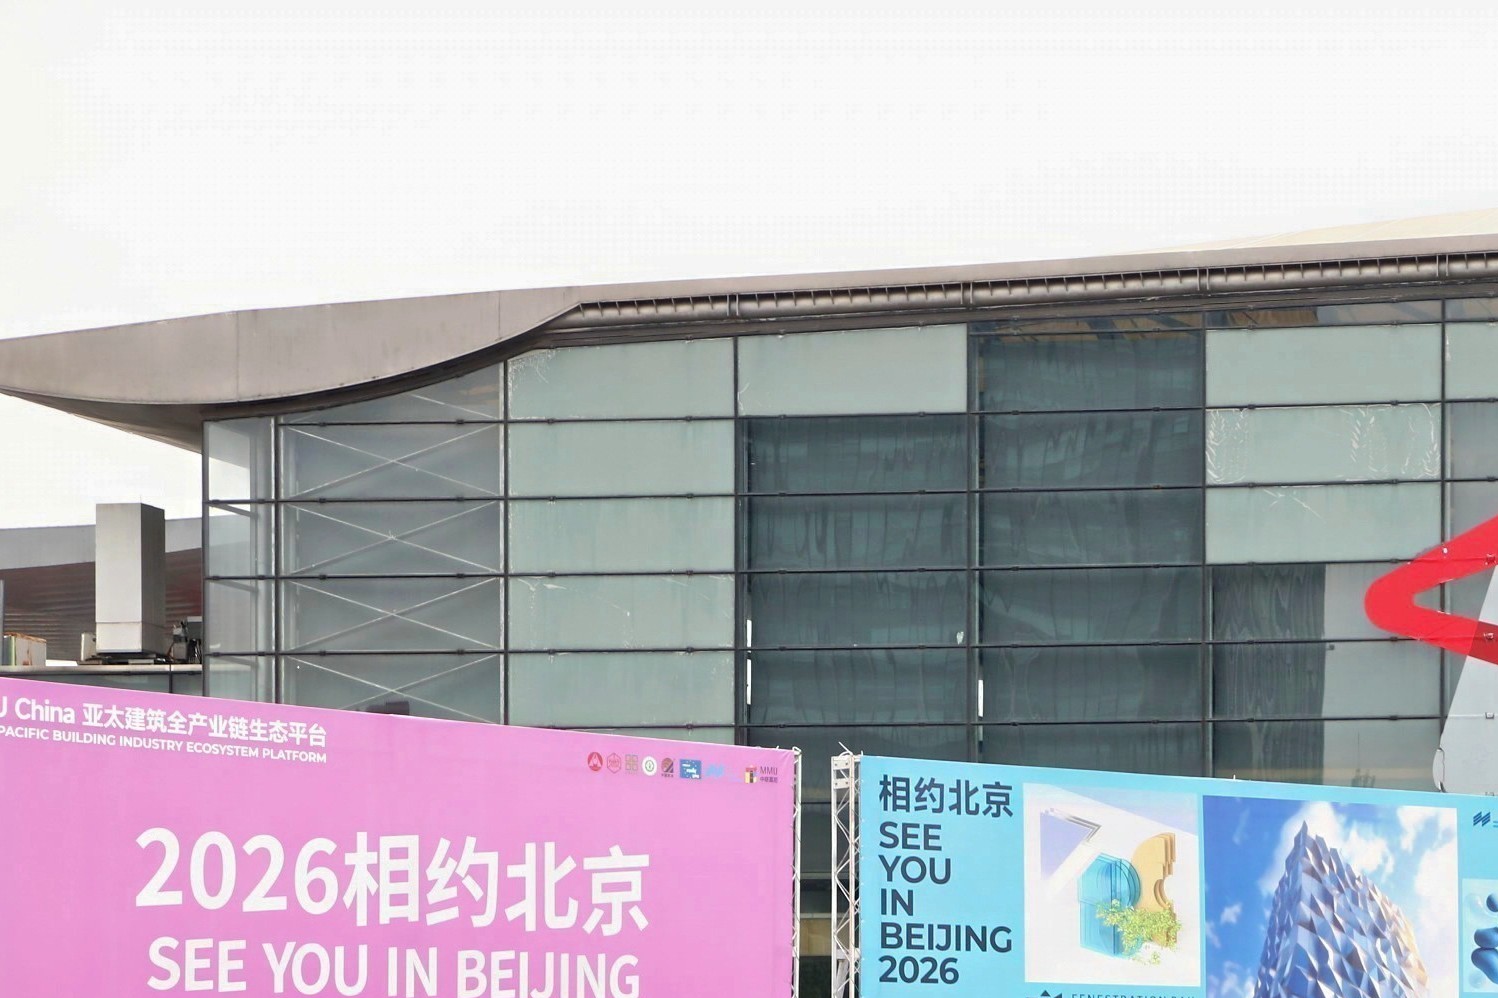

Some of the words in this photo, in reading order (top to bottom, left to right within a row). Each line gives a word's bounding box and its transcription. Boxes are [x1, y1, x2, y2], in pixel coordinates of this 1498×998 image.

[15, 697, 75, 724] China
[82, 702, 327, 748] 亚太建筑全产业链生态平台
[53, 730, 116, 746] BUILDING
[119, 735, 183, 752] INDUSTRY
[186, 741, 259, 758] ECOSYSTEM
[262, 747, 327, 763] PLATFORM
[879, 774, 1014, 818] 相约北京
[879, 821, 942, 851] SEE
[135, 825, 651, 937] 2026相约北京
[878, 854, 951, 885] YOU
[880, 888, 914, 916] IN
[880, 921, 1012, 953] BEIJING
[147, 936, 247, 992] SEE
[263, 941, 369, 998] YOU
[387, 945, 438, 998] IN
[878, 955, 959, 984] 2026
